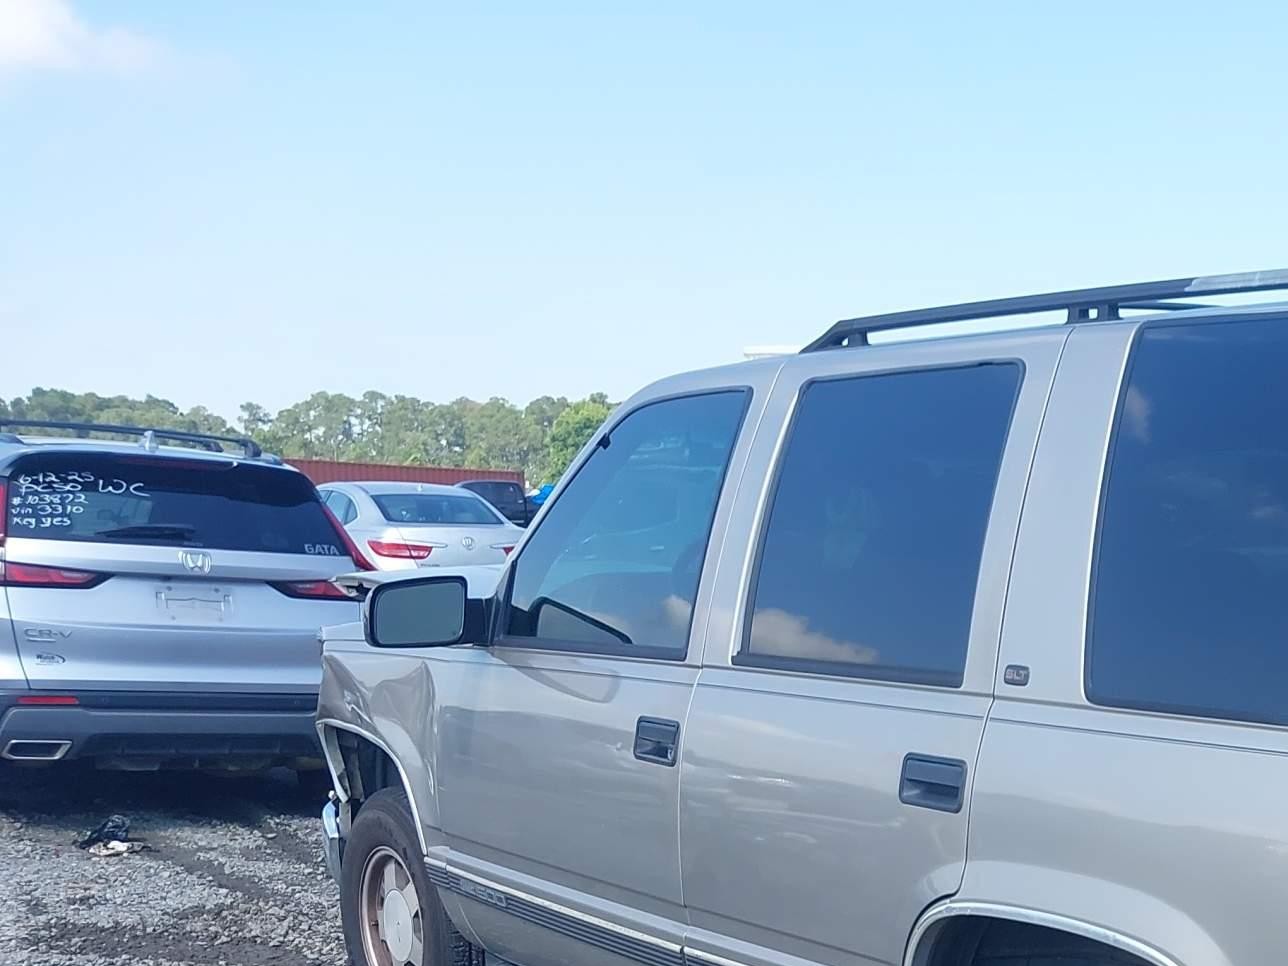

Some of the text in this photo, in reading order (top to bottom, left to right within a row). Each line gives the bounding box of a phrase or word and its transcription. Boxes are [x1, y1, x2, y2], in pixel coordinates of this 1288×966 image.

[37, 504, 84, 515] 3310
[304, 543, 340, 556] GATA
[23, 628, 73, 639] CR-V
